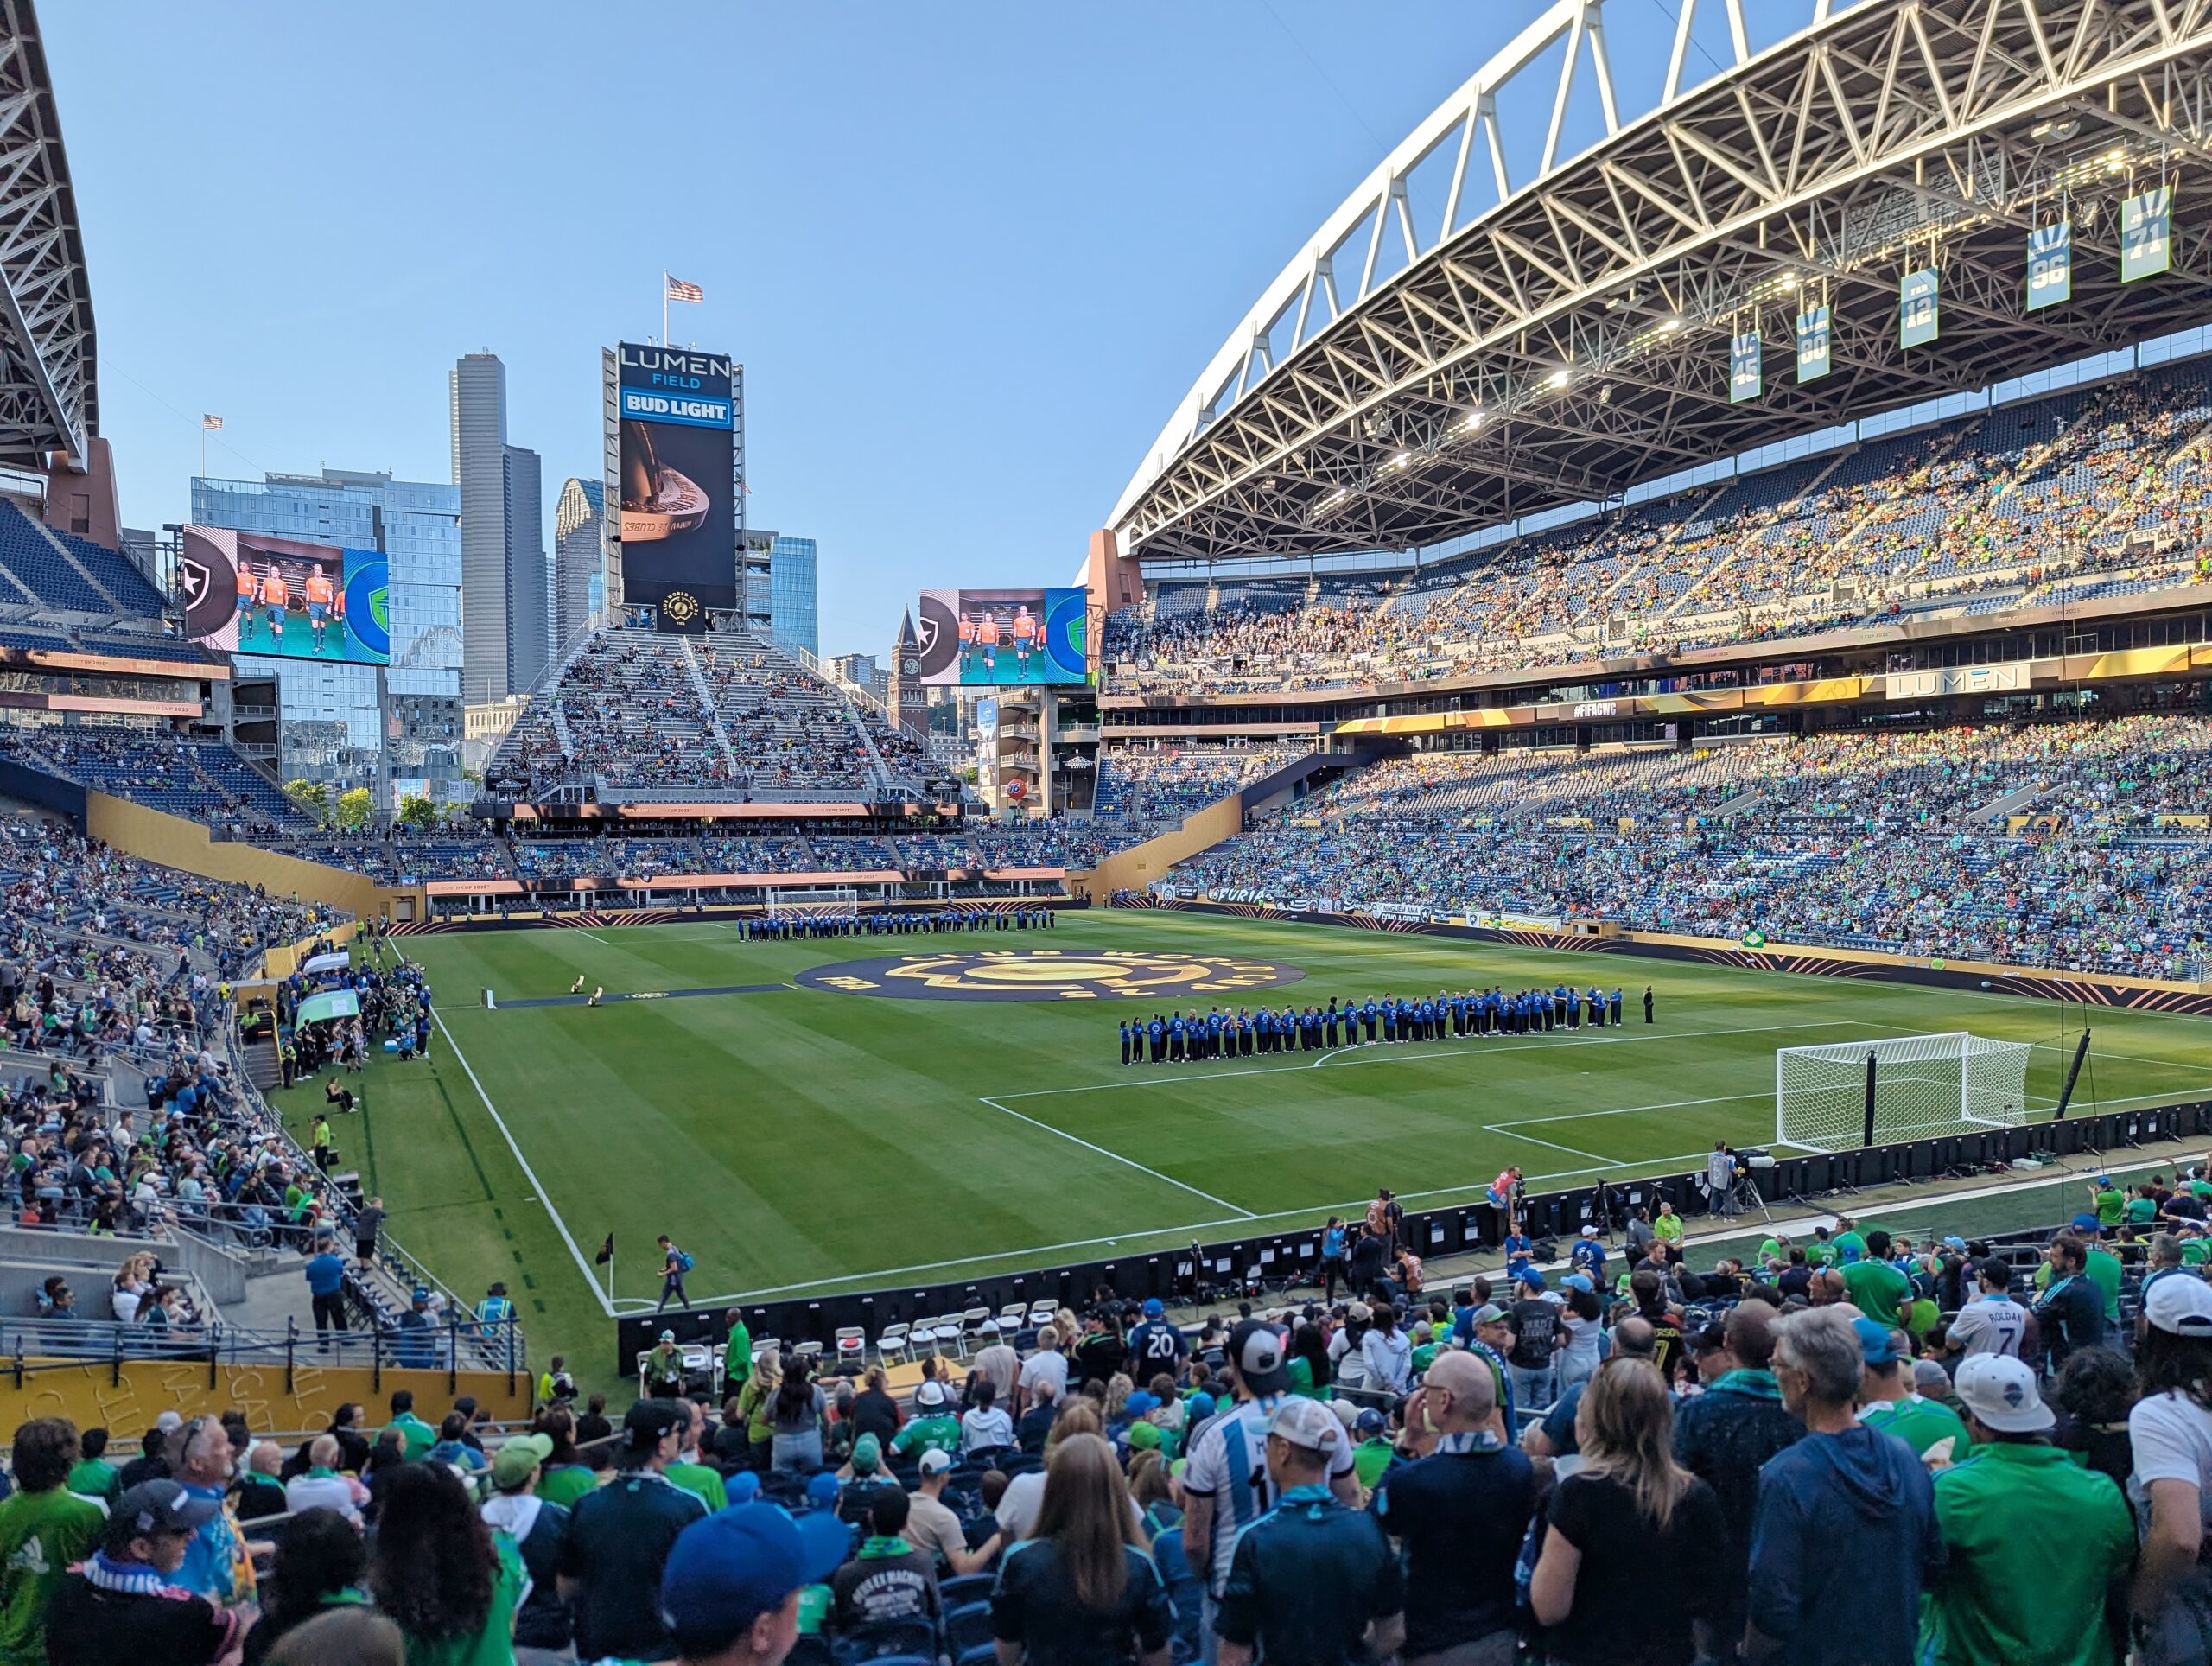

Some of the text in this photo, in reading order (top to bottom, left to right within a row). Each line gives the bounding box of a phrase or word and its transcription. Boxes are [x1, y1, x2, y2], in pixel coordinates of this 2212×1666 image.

[2129, 222, 2162, 260] 71
[2031, 254, 2066, 289] 96
[1906, 296, 1932, 329] 12
[620, 348, 730, 378] LUMEN
[1801, 334, 1827, 365] 80
[652, 373, 701, 389] FIELD
[1733, 357, 1758, 385] 45
[627, 395, 727, 420] BUD LIGHT
[1896, 667, 2018, 696] LUMEN
[1573, 701, 1617, 718] #FIFACWC
[1008, 783, 1020, 794] 76
[816, 976, 881, 990] FIFA
[901, 951, 1062, 961] CLUB
[1103, 951, 1276, 972] WORLD
[1190, 973, 1278, 990] CUP
[1989, 1313, 2022, 1324] ROLDAN
[1147, 1333, 1174, 1358] 20
[1999, 1327, 2015, 1355] 7
